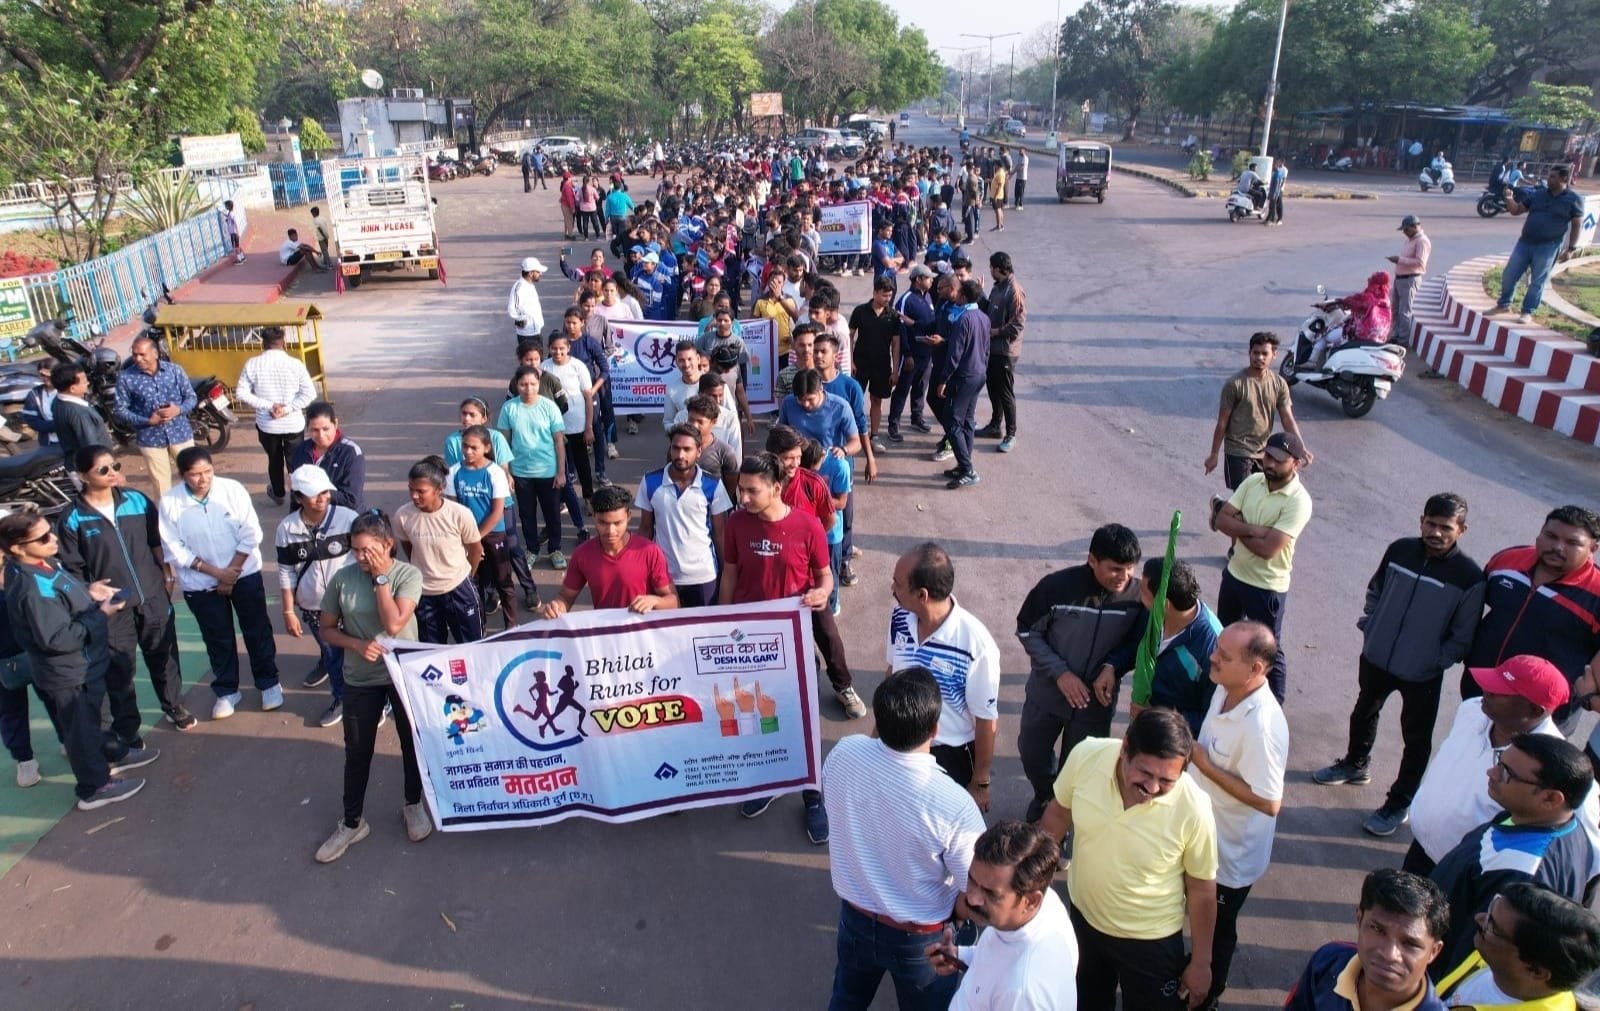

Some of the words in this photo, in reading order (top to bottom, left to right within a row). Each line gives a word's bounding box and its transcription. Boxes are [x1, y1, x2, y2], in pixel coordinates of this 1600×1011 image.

[384, 221, 414, 232] PLEASE
[631, 384, 666, 395] मतदान
[698, 644, 734, 660] चुनाव
[737, 642, 756, 654] का
[759, 637, 779, 652] पर्व
[714, 656, 737, 665] DESH
[739, 655, 752, 664] KA
[753, 653, 778, 663] GARV
[585, 652, 654, 676] Bhilai
[589, 681, 644, 700] Runs
[648, 675, 681, 696] for
[590, 698, 686, 733] VOTE
[483, 759, 514, 771] समाज
[515, 756, 528, 769] की
[529, 753, 567, 768] पहचान,
[450, 779, 466, 790] शत
[467, 774, 500, 789] प्रतिशत
[502, 766, 578, 795] मतदान
[453, 803, 475, 813] जिला
[477, 800, 510, 811] निर्वाचन
[512, 798, 550, 809] अधिकारी
[553, 791, 566, 806] दुर्ग
